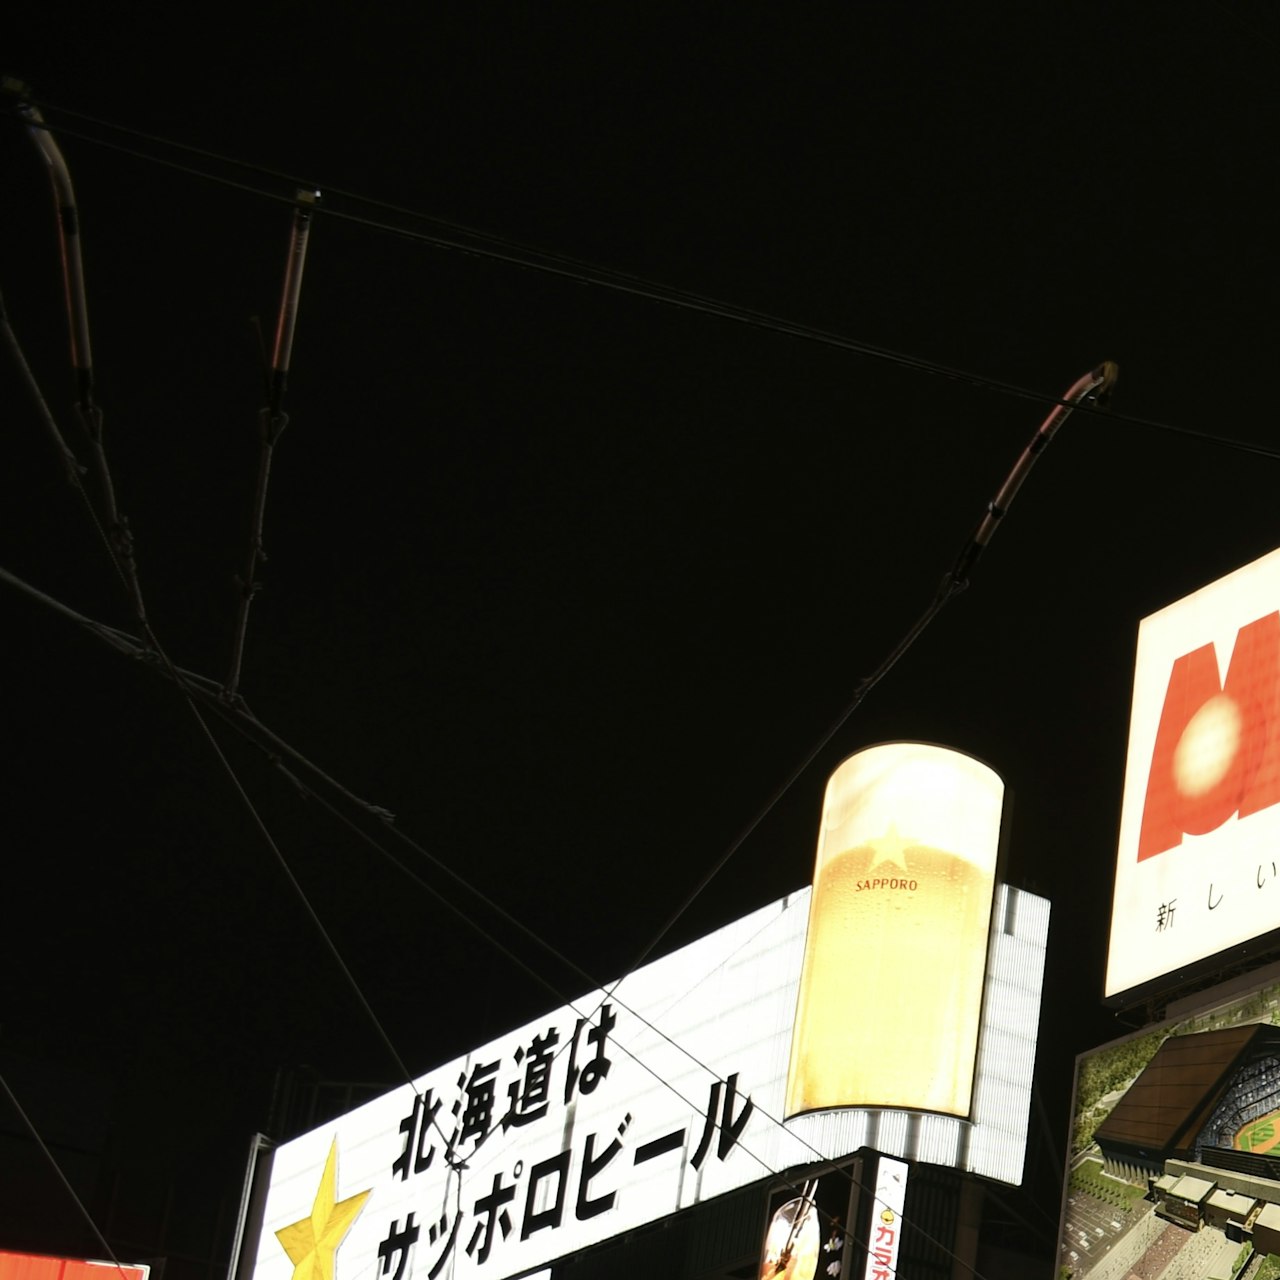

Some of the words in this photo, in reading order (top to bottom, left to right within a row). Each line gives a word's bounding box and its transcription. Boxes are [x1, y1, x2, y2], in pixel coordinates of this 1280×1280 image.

[855, 877, 918, 893] SAPPORO
[392, 1003, 617, 1183] 北海道は
